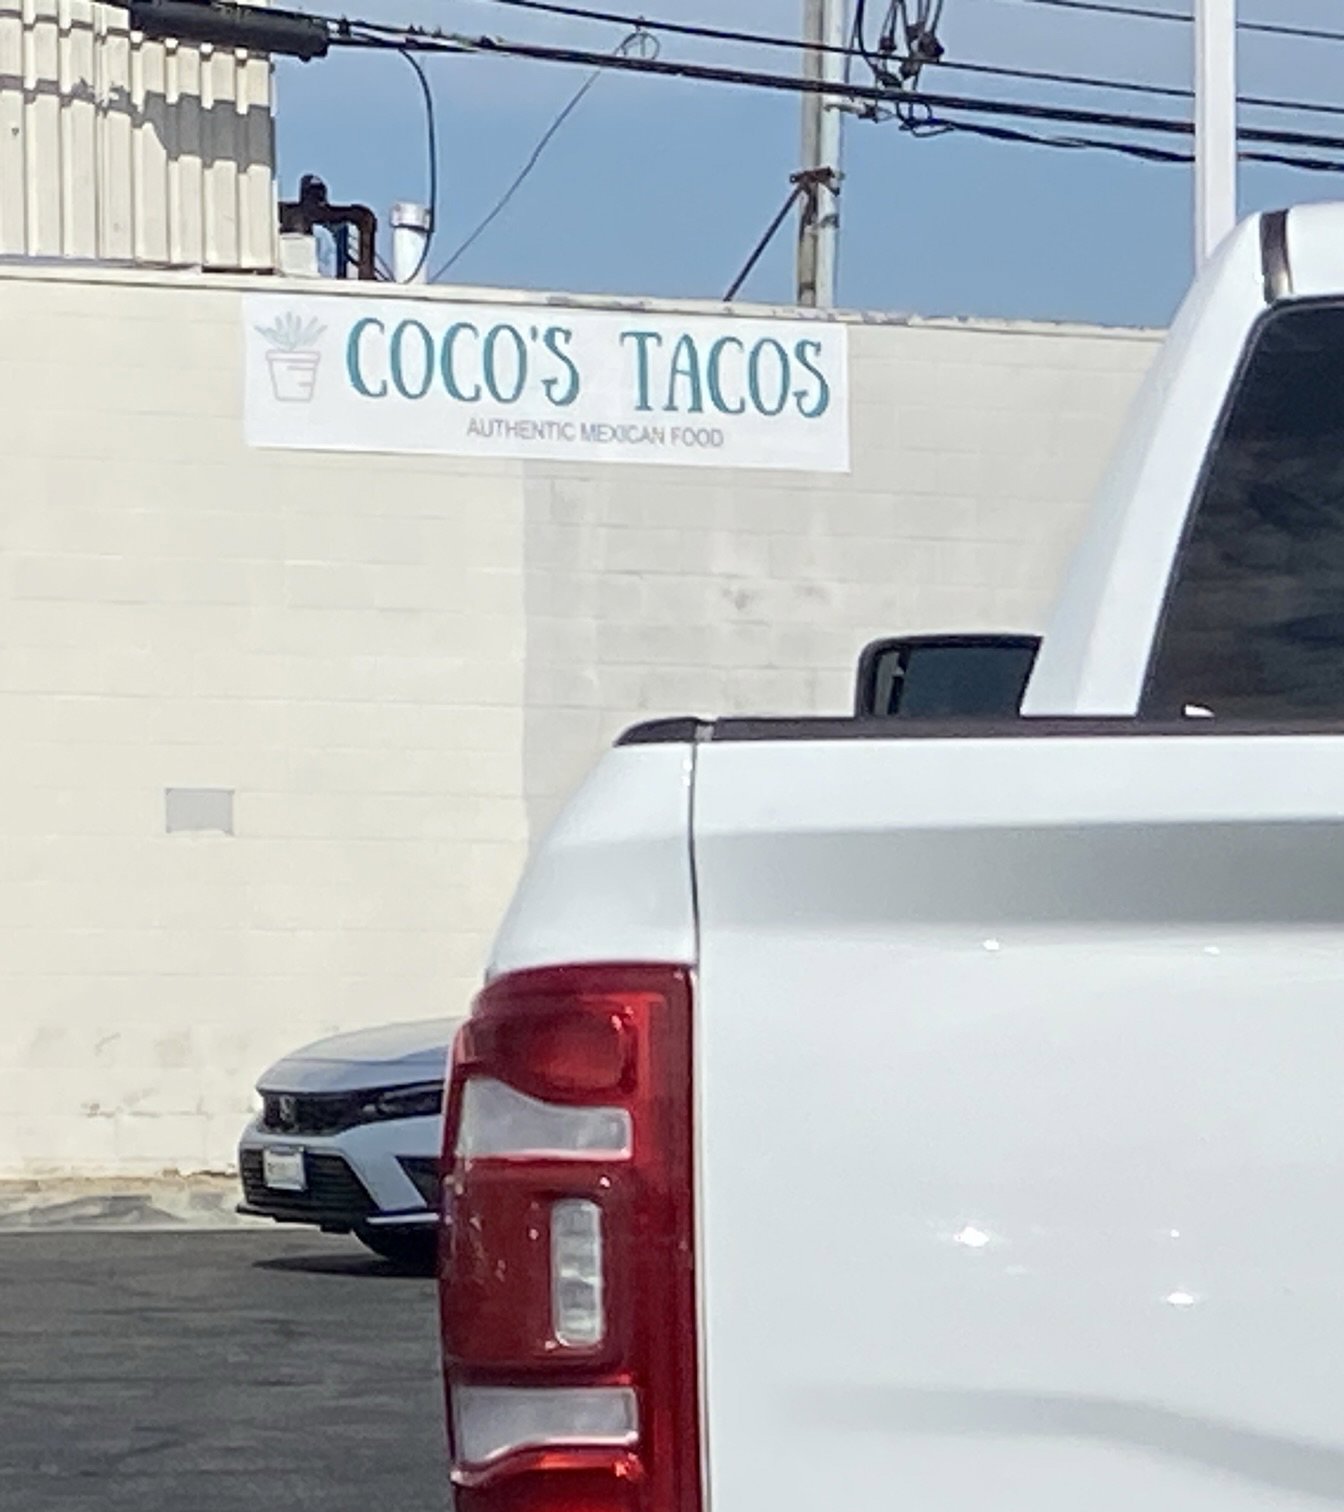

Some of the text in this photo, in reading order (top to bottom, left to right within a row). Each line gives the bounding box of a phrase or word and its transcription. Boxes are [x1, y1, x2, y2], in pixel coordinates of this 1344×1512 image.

[345, 316, 831, 419] COCO'S TACOS
[466, 417, 725, 448] AUTHENTIC MEXICAN FOOD
